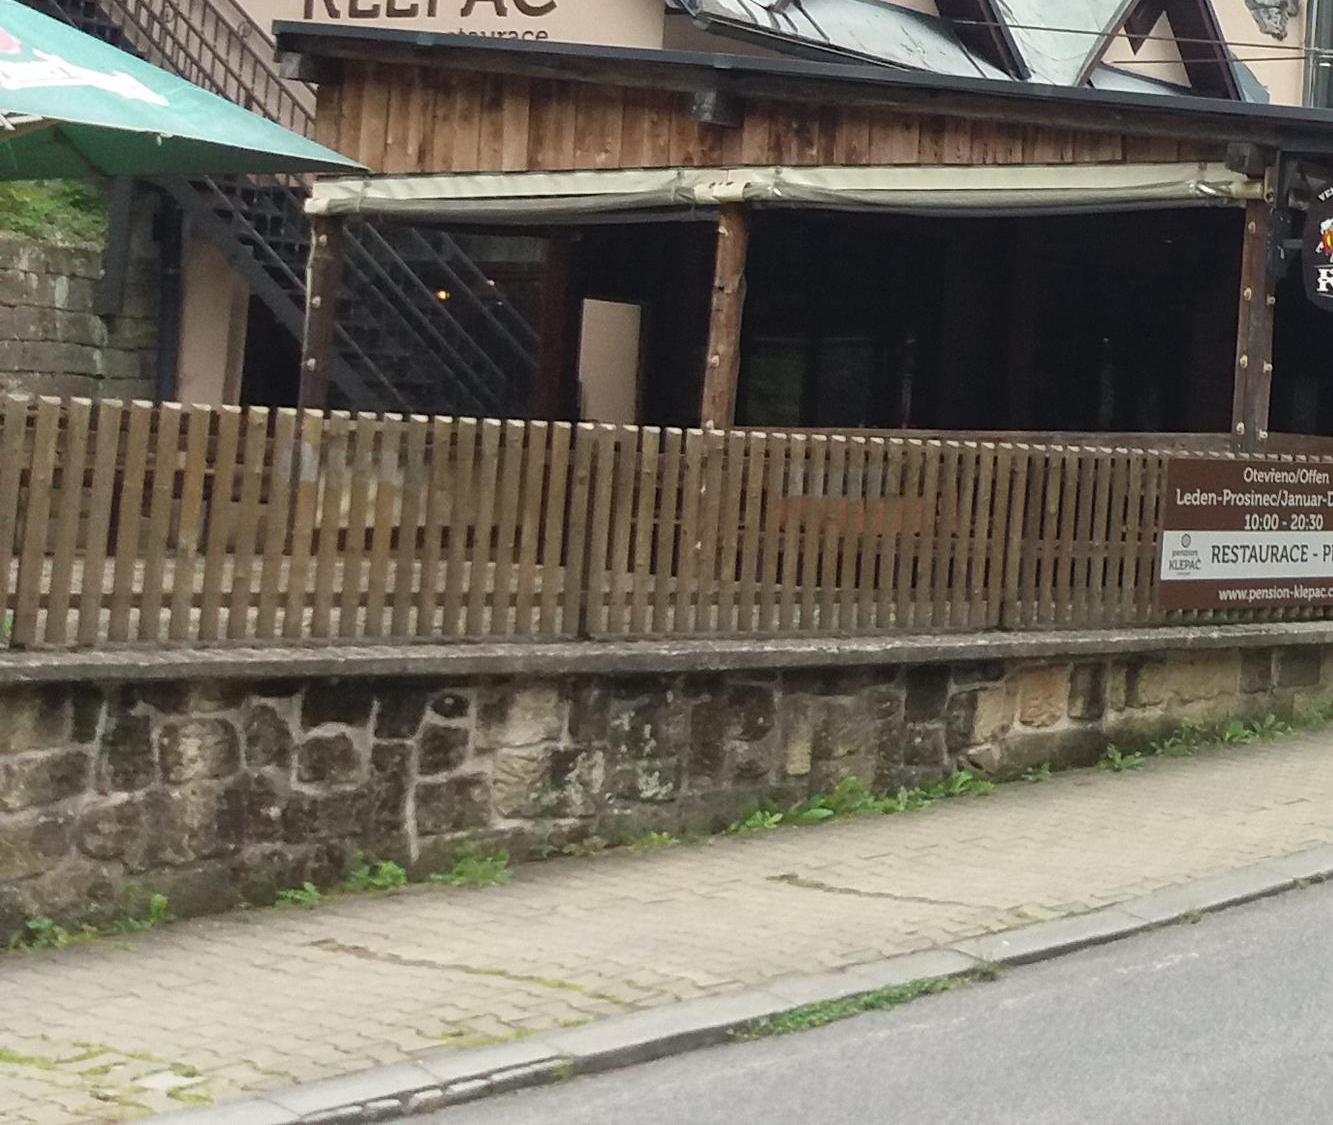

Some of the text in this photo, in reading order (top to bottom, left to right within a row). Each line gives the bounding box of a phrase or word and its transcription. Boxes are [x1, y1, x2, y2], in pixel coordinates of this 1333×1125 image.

[1243, 467, 1330, 484] Otevřeno/Offen
[1244, 513, 1280, 530] 10:00
[1290, 514, 1324, 531] 20:30
[1211, 544, 1309, 563] RESTAURACE
